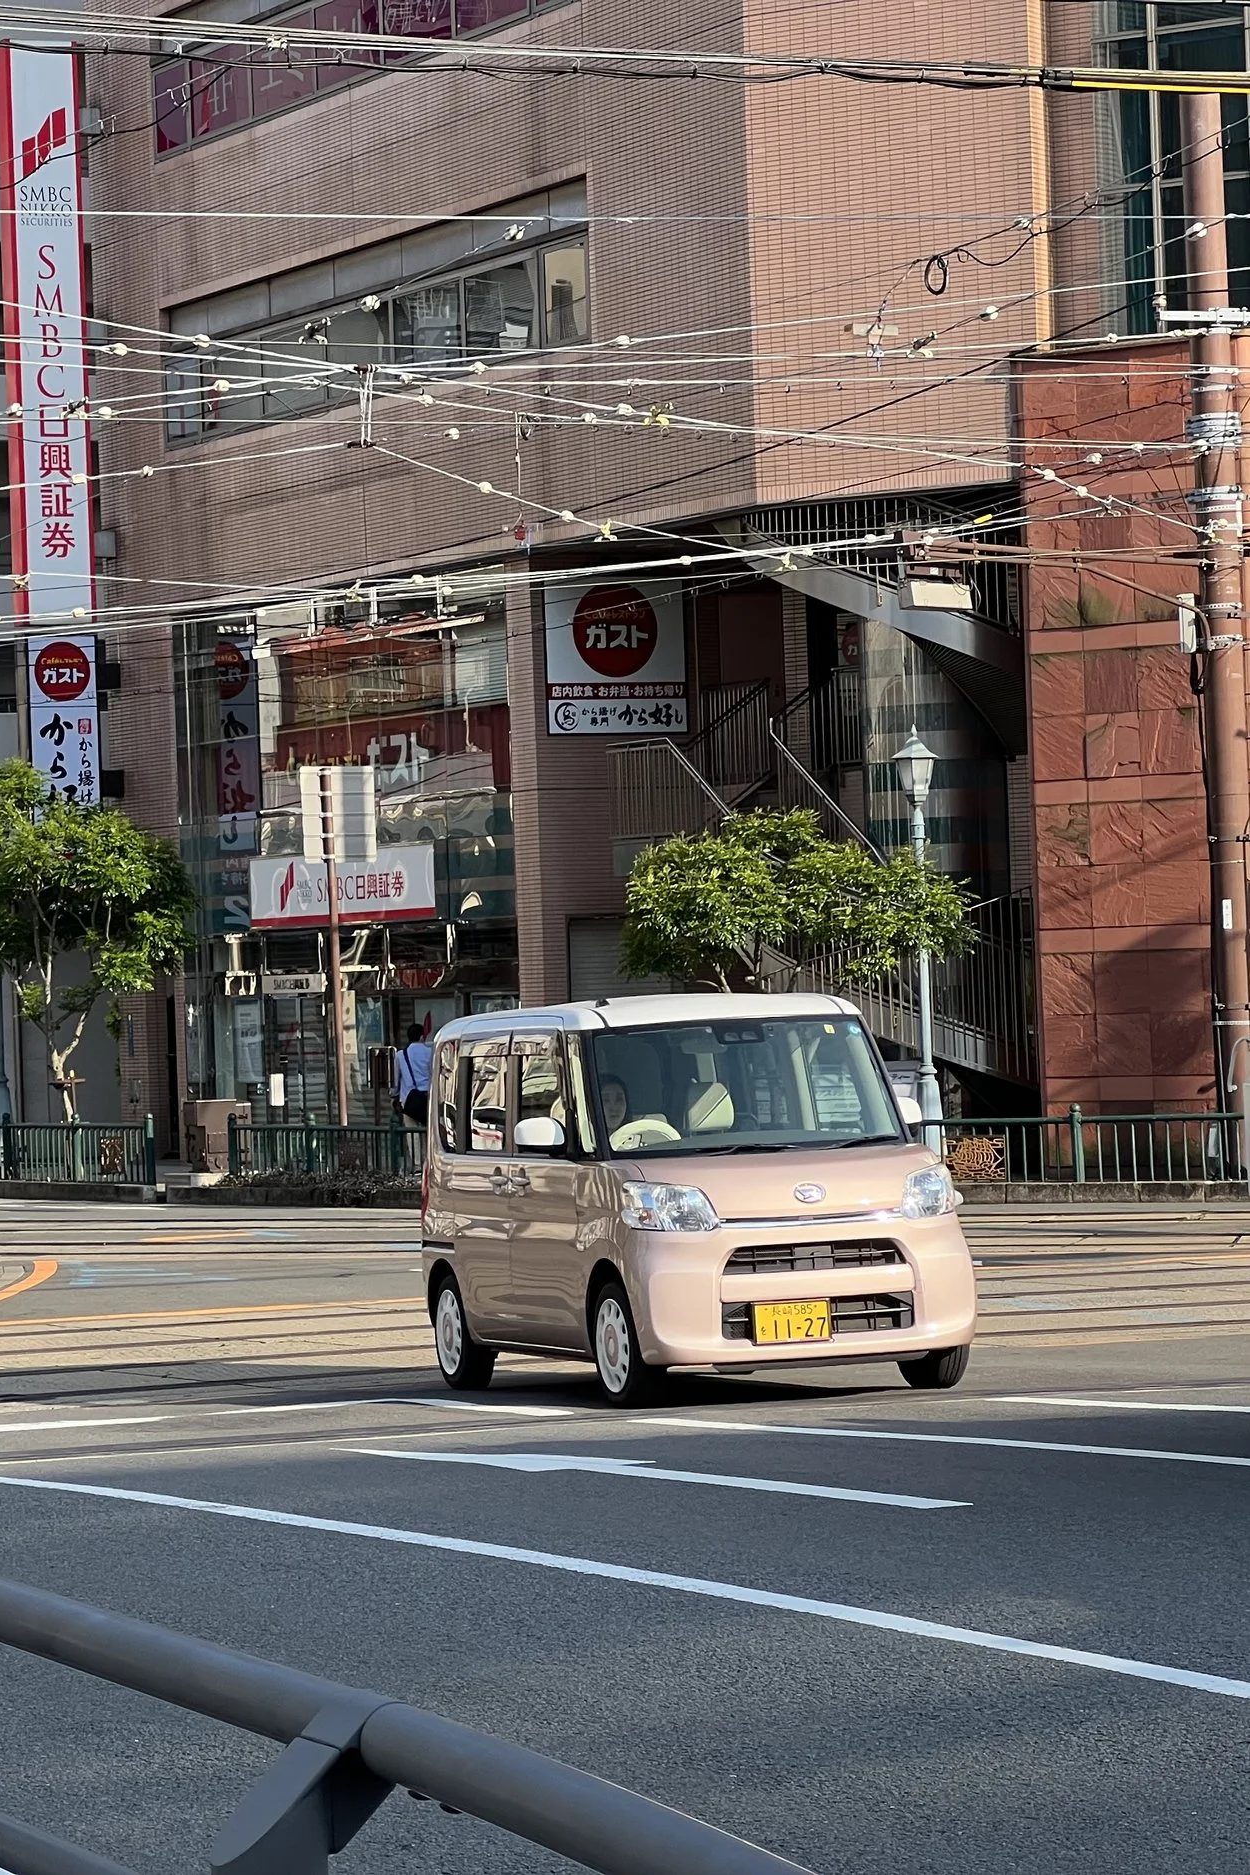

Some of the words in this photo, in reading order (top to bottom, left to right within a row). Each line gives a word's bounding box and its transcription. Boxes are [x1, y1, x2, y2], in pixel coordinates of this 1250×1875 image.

[20, 185, 72, 203] SMBC
[20, 203, 73, 218] NIKKO
[20, 217, 74, 227] SECURITIES
[33, 244, 76, 559] SMBC日興証券
[585, 623, 649, 649] ガスト
[42, 667, 85, 684] ガスト
[617, 702, 684, 728] から好し
[77, 737, 96, 805] から揚げ
[793, 1304, 813, 1316] 585
[774, 1316, 827, 1340] 11-27
